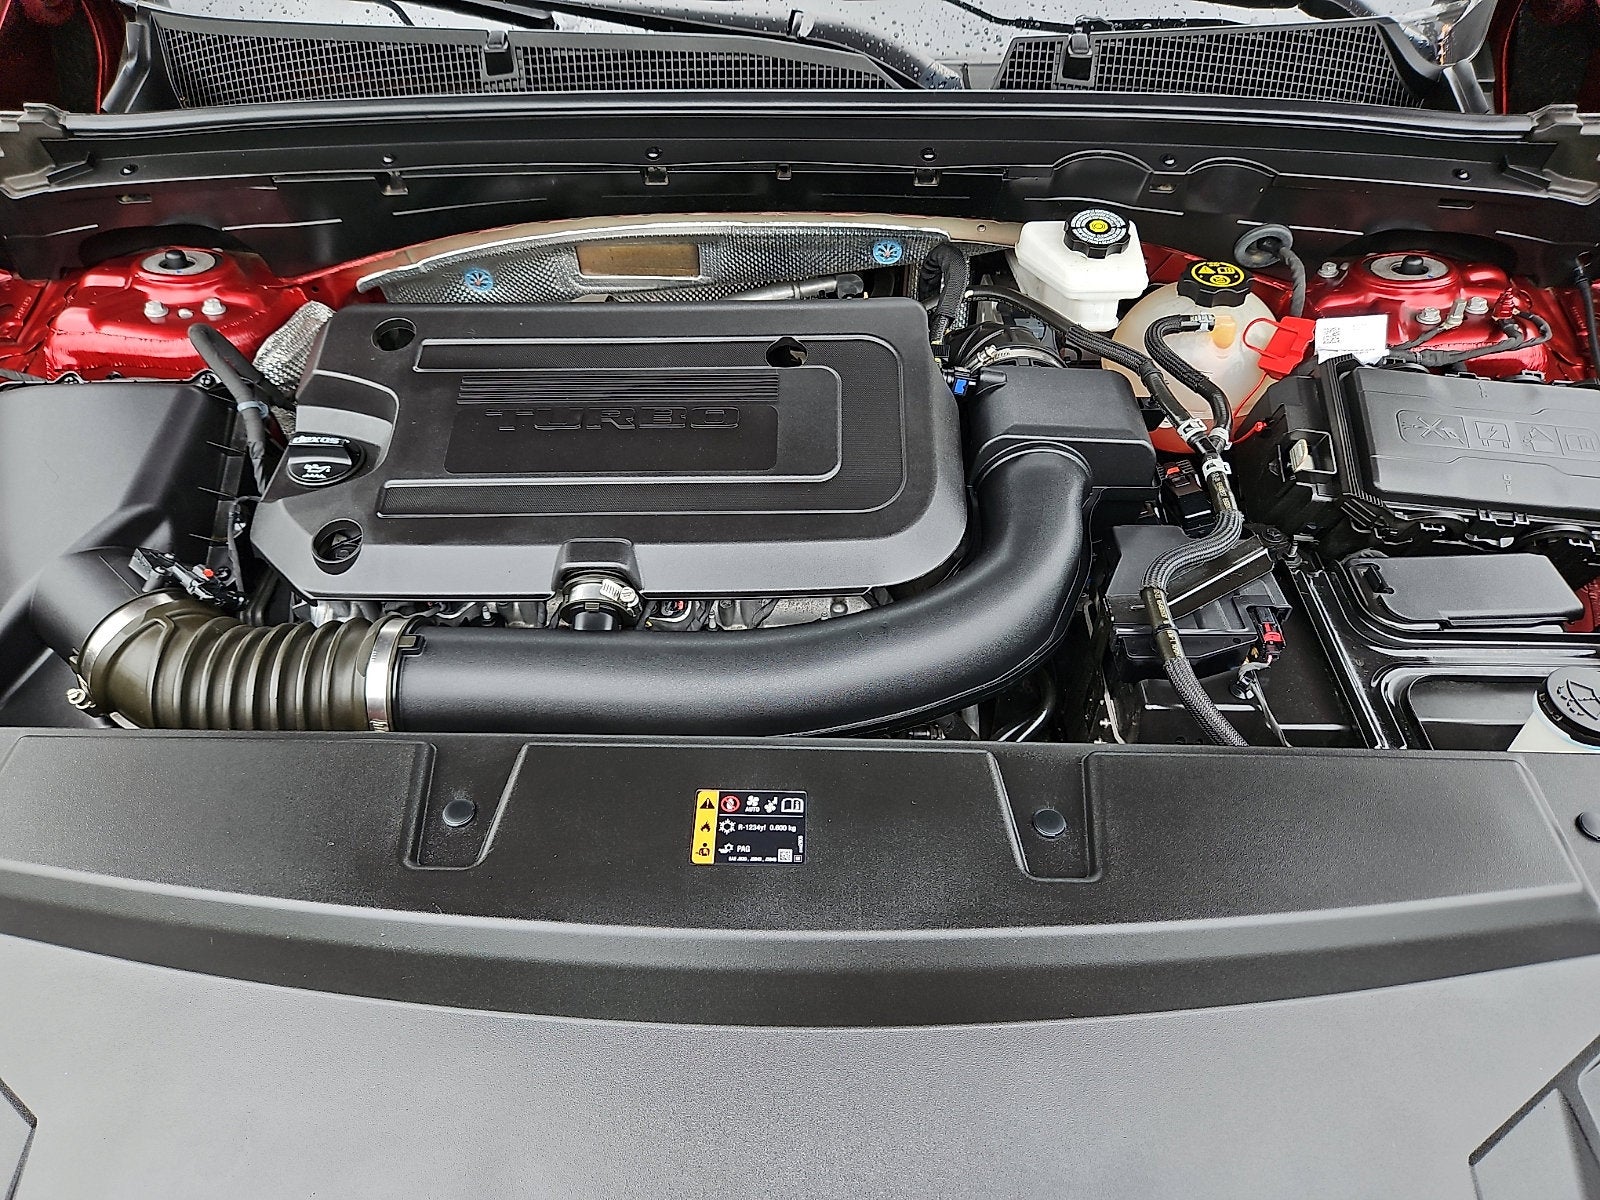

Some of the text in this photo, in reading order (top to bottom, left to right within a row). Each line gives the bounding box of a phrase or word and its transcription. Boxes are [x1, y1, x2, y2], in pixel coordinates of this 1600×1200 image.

[485, 406, 740, 431] TURBO
[737, 823, 766, 832] R-1234yf
[788, 824, 797, 833] kg
[736, 845, 751, 853] PAG
